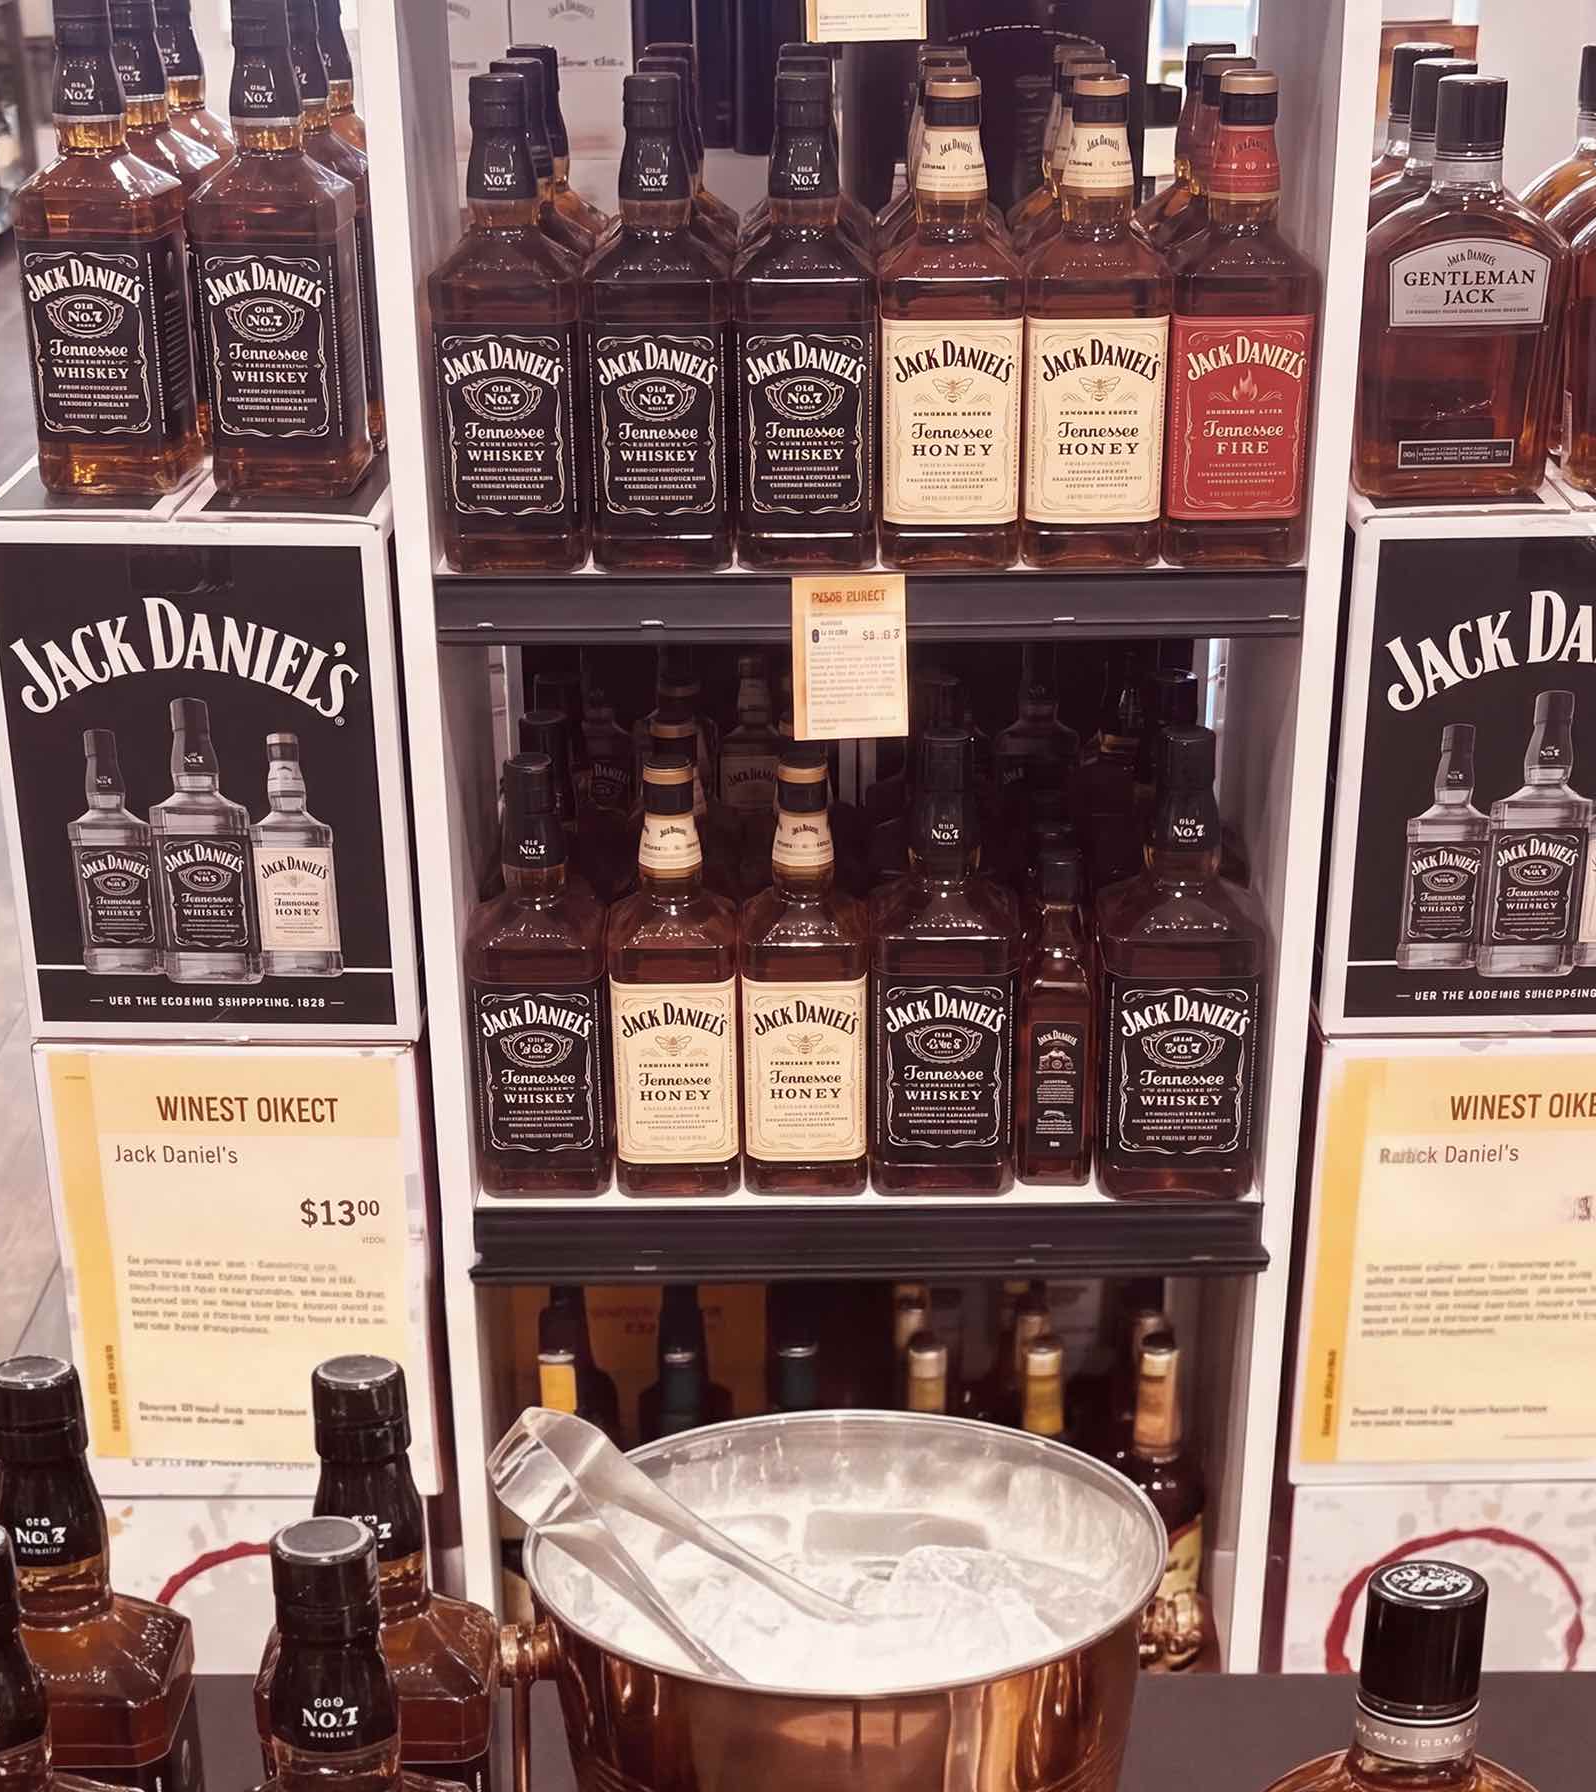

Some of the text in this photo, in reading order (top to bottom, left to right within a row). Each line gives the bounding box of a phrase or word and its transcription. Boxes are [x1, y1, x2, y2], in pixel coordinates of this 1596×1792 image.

[24, 258, 145, 304] JACK DANIEL'S
[204, 262, 326, 308] JACK DANIEL'S
[1403, 269, 1536, 287] GENTLEMAN
[1443, 288, 1495, 306] JACK
[50, 339, 128, 357] Tennessee
[229, 343, 309, 361] Tennessee
[442, 341, 564, 386] JACK DANIEL'S
[597, 341, 718, 386] JACK DANIEL'S
[745, 341, 867, 386] JACK DANIEL'S
[893, 340, 1015, 384] JACK DANIEL'S
[1041, 339, 1161, 383] JACK DANIEL'S
[1187, 336, 1306, 383] JACK DANIEL'S
[53, 367, 129, 379] WHISKEY
[232, 371, 309, 383] WHISKEY
[465, 422, 545, 440] Tennessee
[619, 422, 698, 440] Tennessee
[765, 421, 845, 439] Tennessee
[911, 422, 994, 440] Tennessee
[1057, 421, 1140, 439] Tennessee
[1203, 420, 1284, 438] Tennessee
[467, 450, 545, 462] WHISKEY
[620, 450, 698, 462] WHISKEY
[767, 448, 845, 462] WHISKEY
[912, 444, 994, 457] HONEY
[1058, 442, 1140, 456] HONEY
[1216, 441, 1269, 455] FIRE
[9, 597, 359, 719] JACK DANIEL'S
[1384, 610, 1519, 712] JACK
[164, 848, 193, 873] JACK
[1496, 842, 1527, 867] JACK
[275, 908, 321, 916] HONEY
[109, 997, 131, 1005] UER
[135, 997, 157, 1006] THE
[1415, 992, 1437, 1000] UER
[1442, 991, 1464, 1000] THE
[481, 1000, 593, 1038] JACK DANIEL'S
[621, 1002, 728, 1038] JACK DANIEL'S
[753, 1000, 860, 1036] JACK DANIEL'S
[886, 992, 1007, 1034] JACK DANIEL'S
[1121, 995, 1251, 1038] JACK DANIEL'S
[501, 1069, 576, 1085] Tennessee
[639, 1072, 712, 1087] Tennessee
[770, 1070, 842, 1086] Tennessee
[904, 1064, 984, 1081] Tennessee
[1140, 1069, 1225, 1086] Tennessee
[504, 1093, 575, 1104] WHISKEY
[639, 1090, 711, 1101] HONEY
[770, 1088, 842, 1099] HONEY
[905, 1090, 983, 1101] WHISKEY
[1140, 1095, 1222, 1106] WHISKEY
[156, 1095, 339, 1123] WINEST OIKECT
[1450, 1094, 1542, 1120] WINEST
[115, 1144, 239, 1164] Jack Daniel's
[1444, 1144, 1519, 1164] Daniel's
